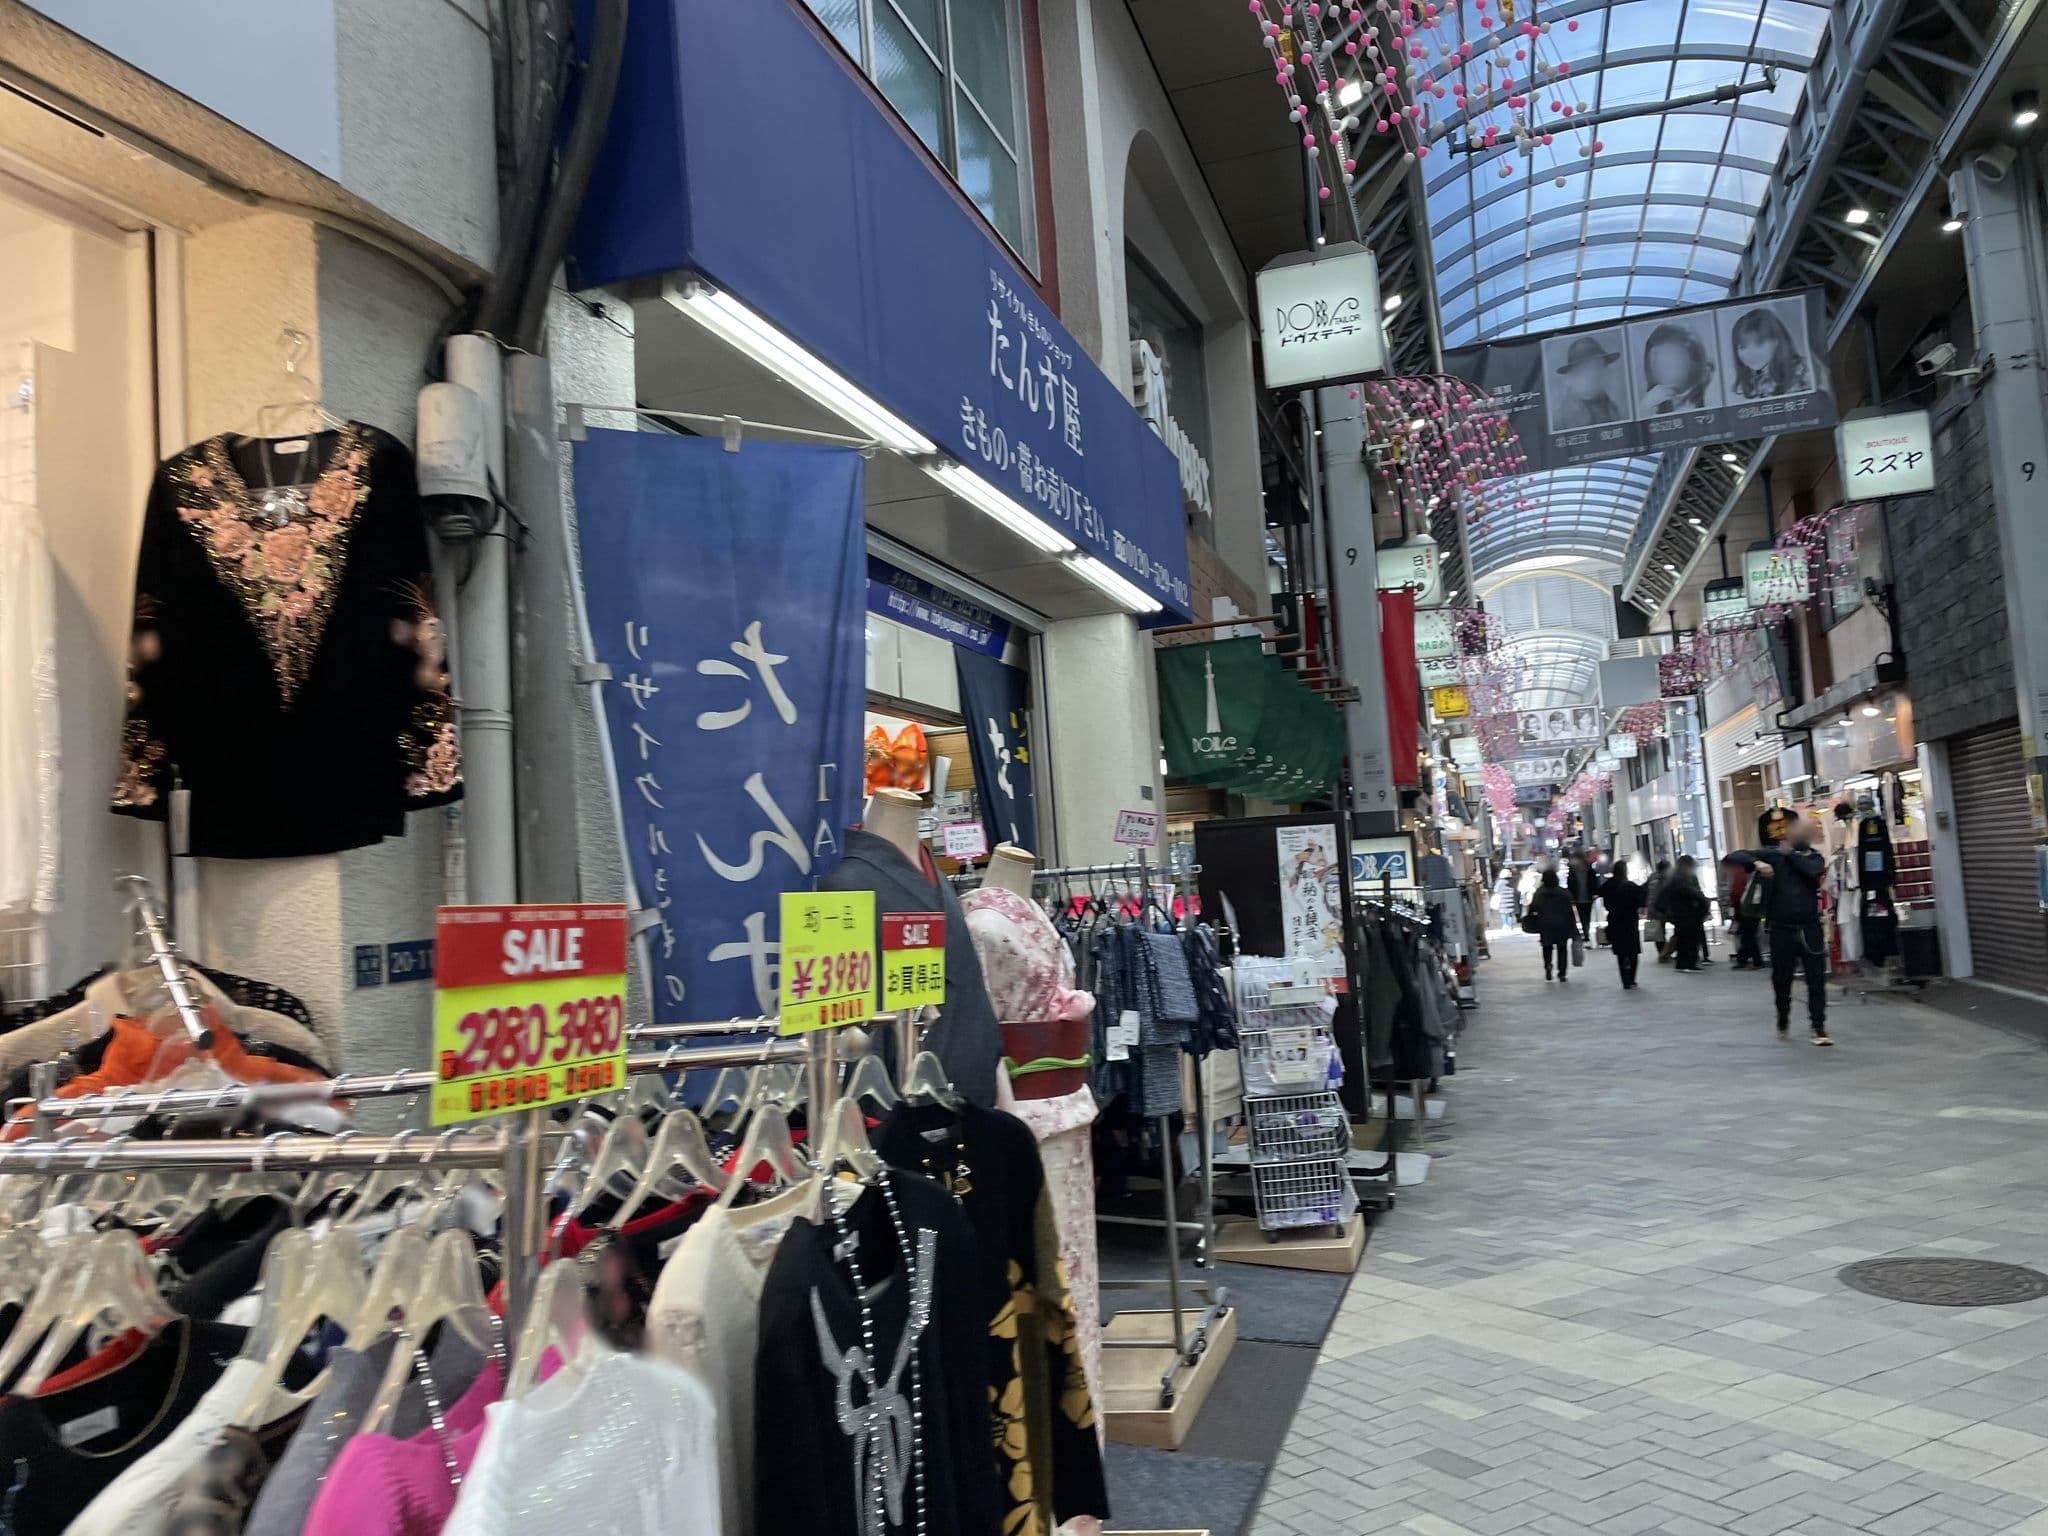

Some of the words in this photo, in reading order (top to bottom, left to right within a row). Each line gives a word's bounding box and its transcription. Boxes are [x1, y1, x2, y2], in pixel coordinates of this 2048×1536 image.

[986, 299, 1084, 457] たんす屋
[1855, 451, 1924, 476] スズヤ
[2021, 461, 2036, 482] 9
[1346, 547, 1358, 566] 9
[902, 924, 930, 946] SALE
[501, 927, 585, 976] SALE
[791, 950, 872, 1000] ¥3980
